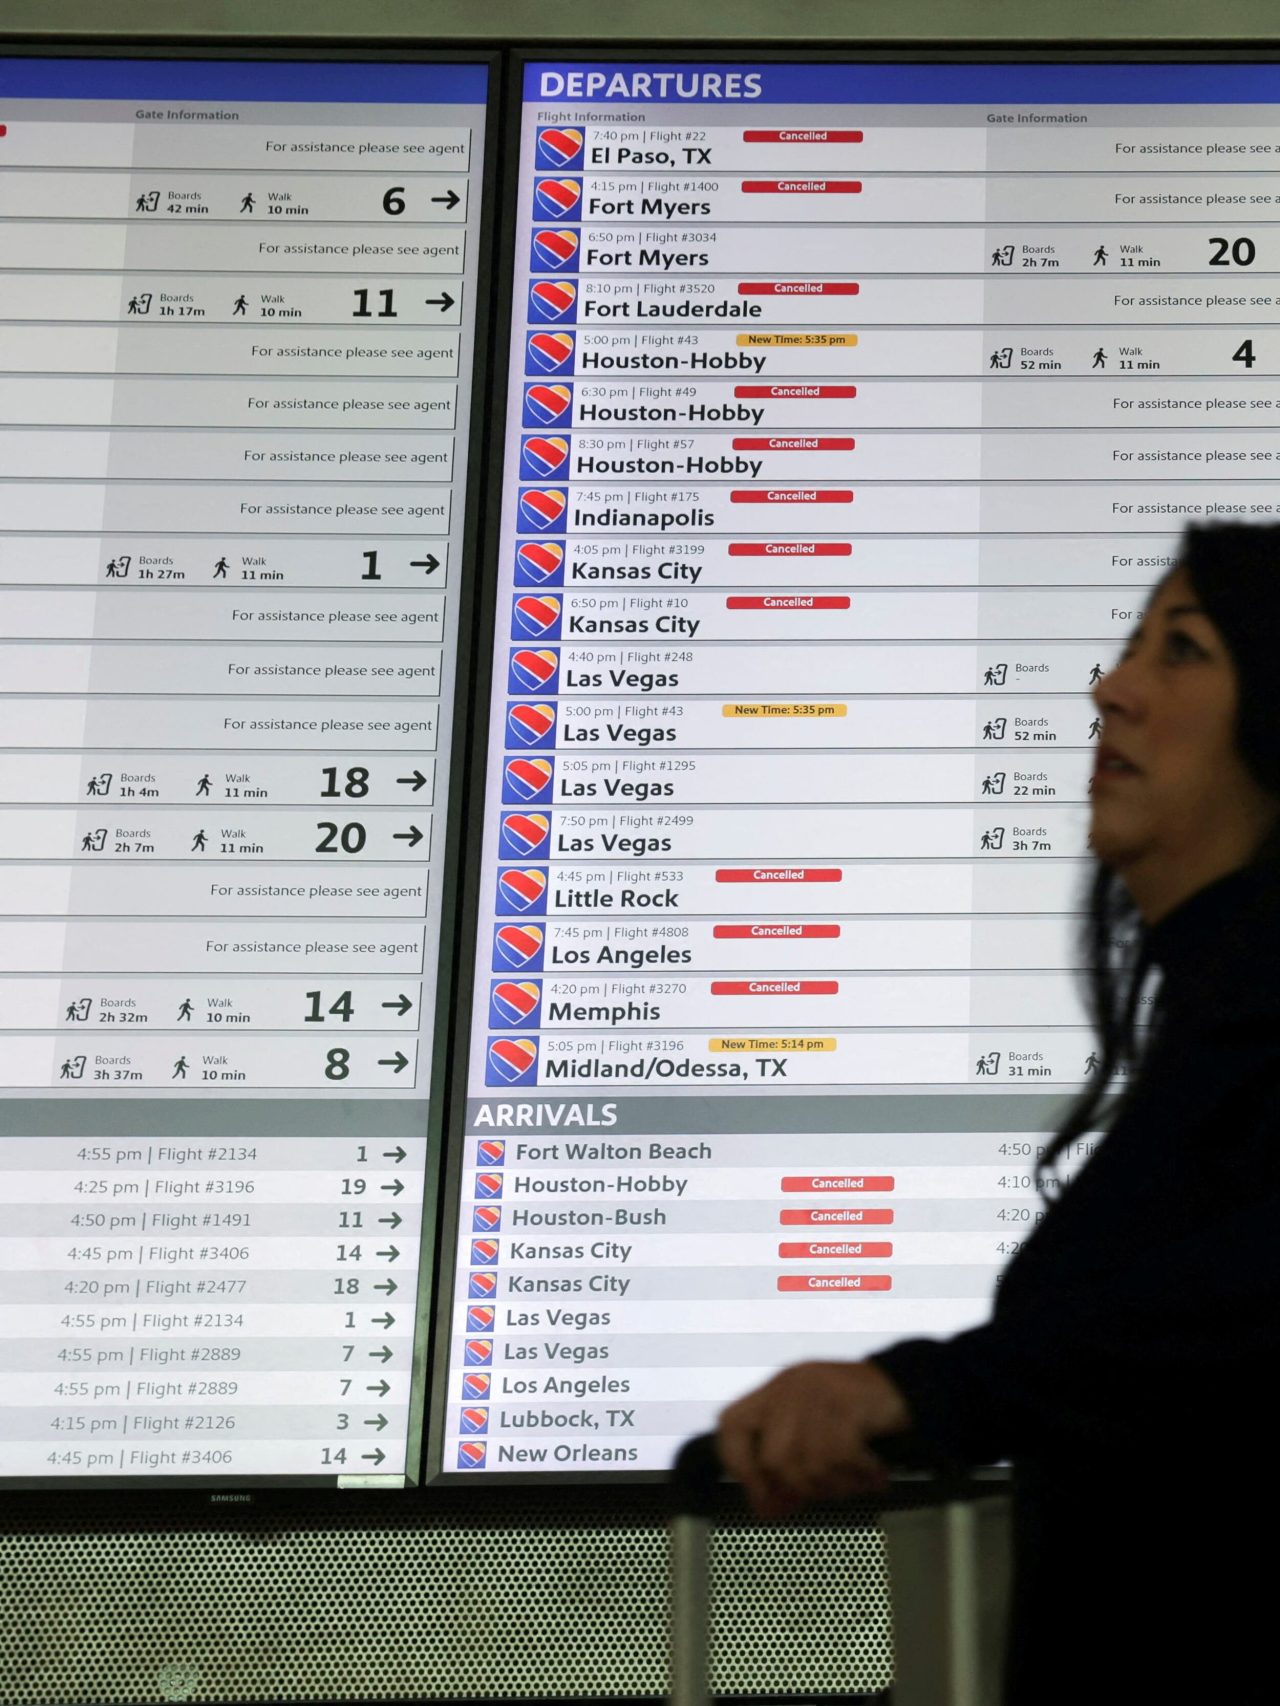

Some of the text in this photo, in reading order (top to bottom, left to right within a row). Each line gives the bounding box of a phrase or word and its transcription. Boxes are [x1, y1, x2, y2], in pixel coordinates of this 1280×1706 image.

[541, 72, 761, 97] DEPARTURES
[136, 110, 239, 120] Gate Information
[538, 112, 645, 123] Flight Information
[987, 113, 1087, 123] Gate Information
[779, 132, 827, 140] Cancelled
[266, 141, 286, 151] For
[291, 143, 355, 152] assistance
[359, 143, 399, 155] please
[429, 145, 464, 155] agent
[592, 147, 711, 167] El Paso, TX
[1116, 143, 1135, 153] For
[1140, 144, 1202, 153] assistance
[1207, 144, 1246, 155] please
[591, 182, 614, 191] 4:15
[619, 184, 636, 193] pm
[648, 182, 679, 193] Flight
[684, 182, 718, 191] #1400
[167, 204, 208, 213] 42 min
[269, 206, 308, 214] 10 min
[383, 187, 405, 215] 6
[590, 199, 710, 219] Fort Myers
[1209, 238, 1255, 266] 20
[353, 289, 397, 317] 11
[585, 300, 761, 317] Fort Lauderdale
[583, 352, 766, 373] Houston-Hobby
[1232, 340, 1256, 368] 4
[575, 509, 714, 531] Indianapolis
[573, 562, 702, 584] Kansas City
[567, 670, 678, 691] Las Vegas
[321, 767, 369, 798] 18
[316, 822, 366, 853] 20
[556, 889, 678, 907] Little Rock
[552, 945, 691, 968] Los Angeles
[549, 1002, 660, 1025] Memphis
[325, 1048, 349, 1080] 8
[546, 1057, 787, 1080] Midland/Odessa, TX
[473, 1104, 617, 1126] ARRIVALS
[517, 1142, 711, 1160] Fort Walton Beach
[74, 1181, 107, 1193] 4:25
[113, 1184, 138, 1196] pm
[156, 1181, 199, 1197] Flight
[206, 1181, 254, 1193] #3196
[342, 1179, 366, 1194] 19
[812, 1178, 863, 1188] Cancelled
[513, 1208, 665, 1225] Houston-Bush
[511, 1242, 632, 1263] Kansas City
[501, 1410, 635, 1430] Lubbock, TX
[321, 1448, 346, 1464] 14
[499, 1444, 637, 1462] New Orleans
[210, 1494, 251, 1502] SAMSUNG
